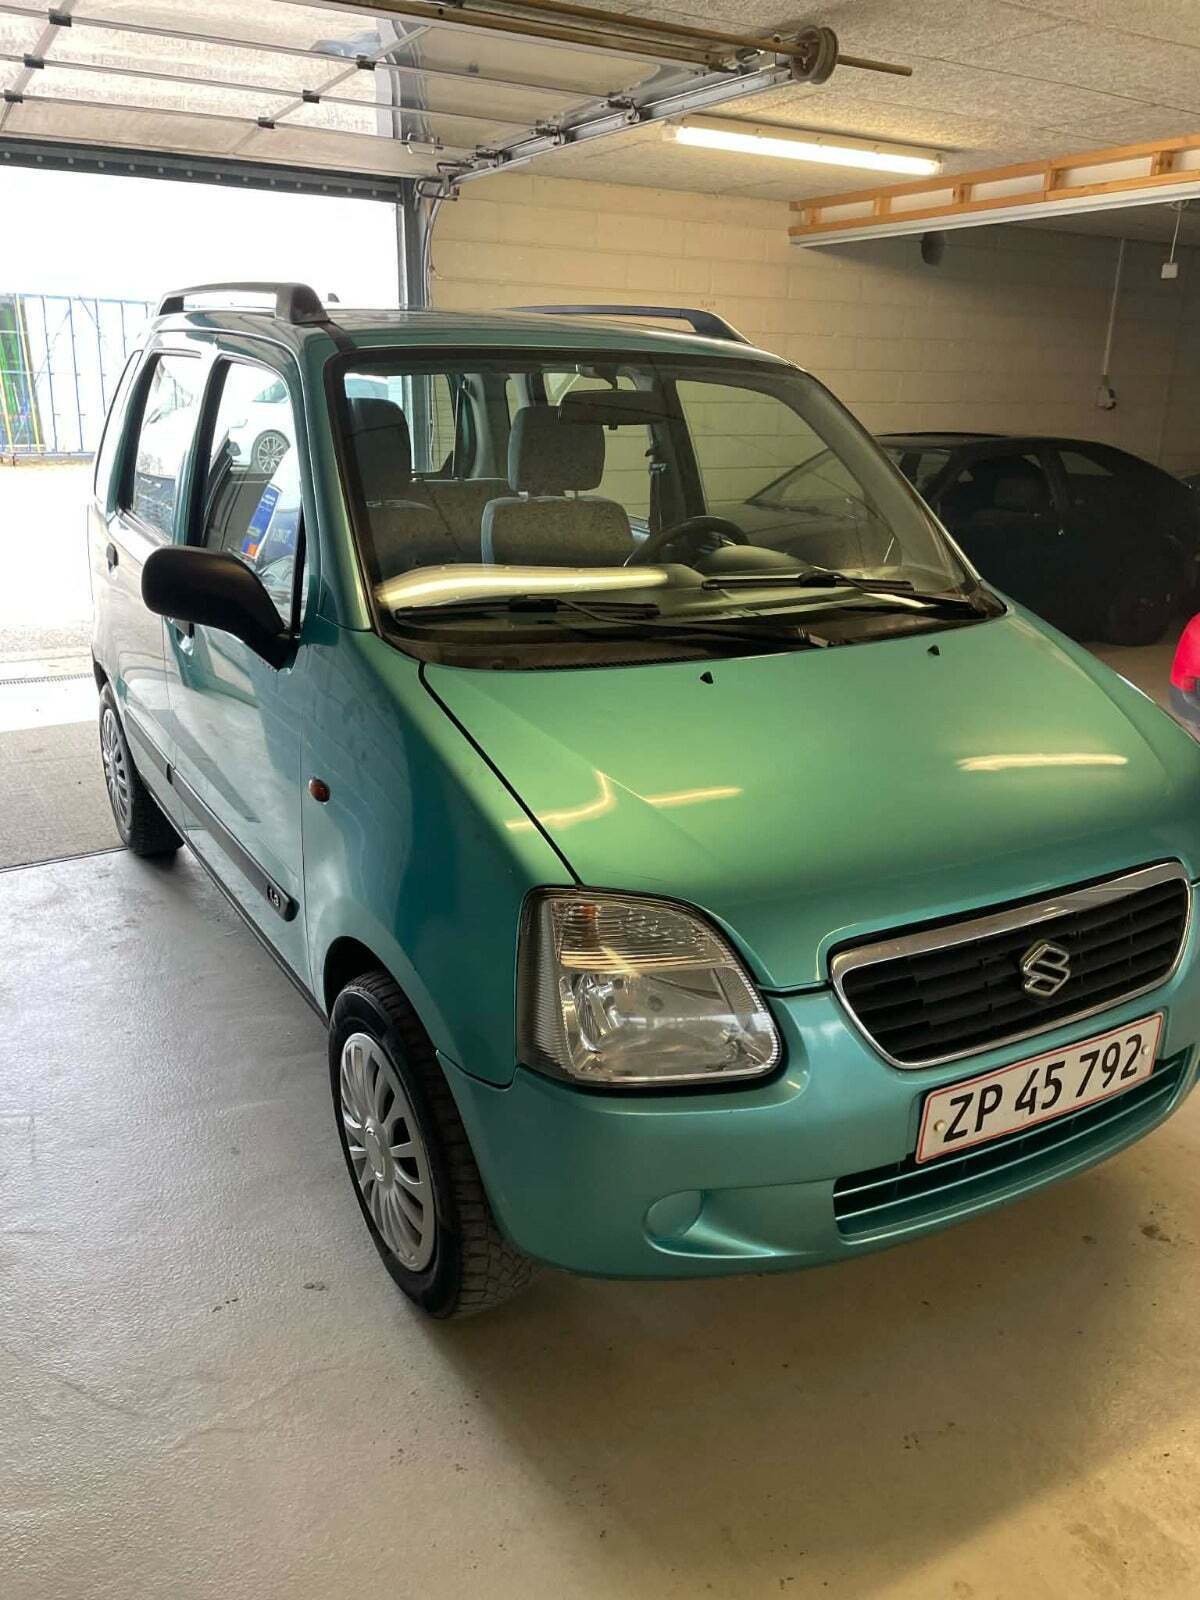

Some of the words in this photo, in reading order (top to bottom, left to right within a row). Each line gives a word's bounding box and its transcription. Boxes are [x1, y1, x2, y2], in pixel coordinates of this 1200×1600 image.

[943, 1083, 1004, 1143] ZP
[1014, 1060, 1066, 1115] 45
[1075, 1033, 1143, 1098] 792
